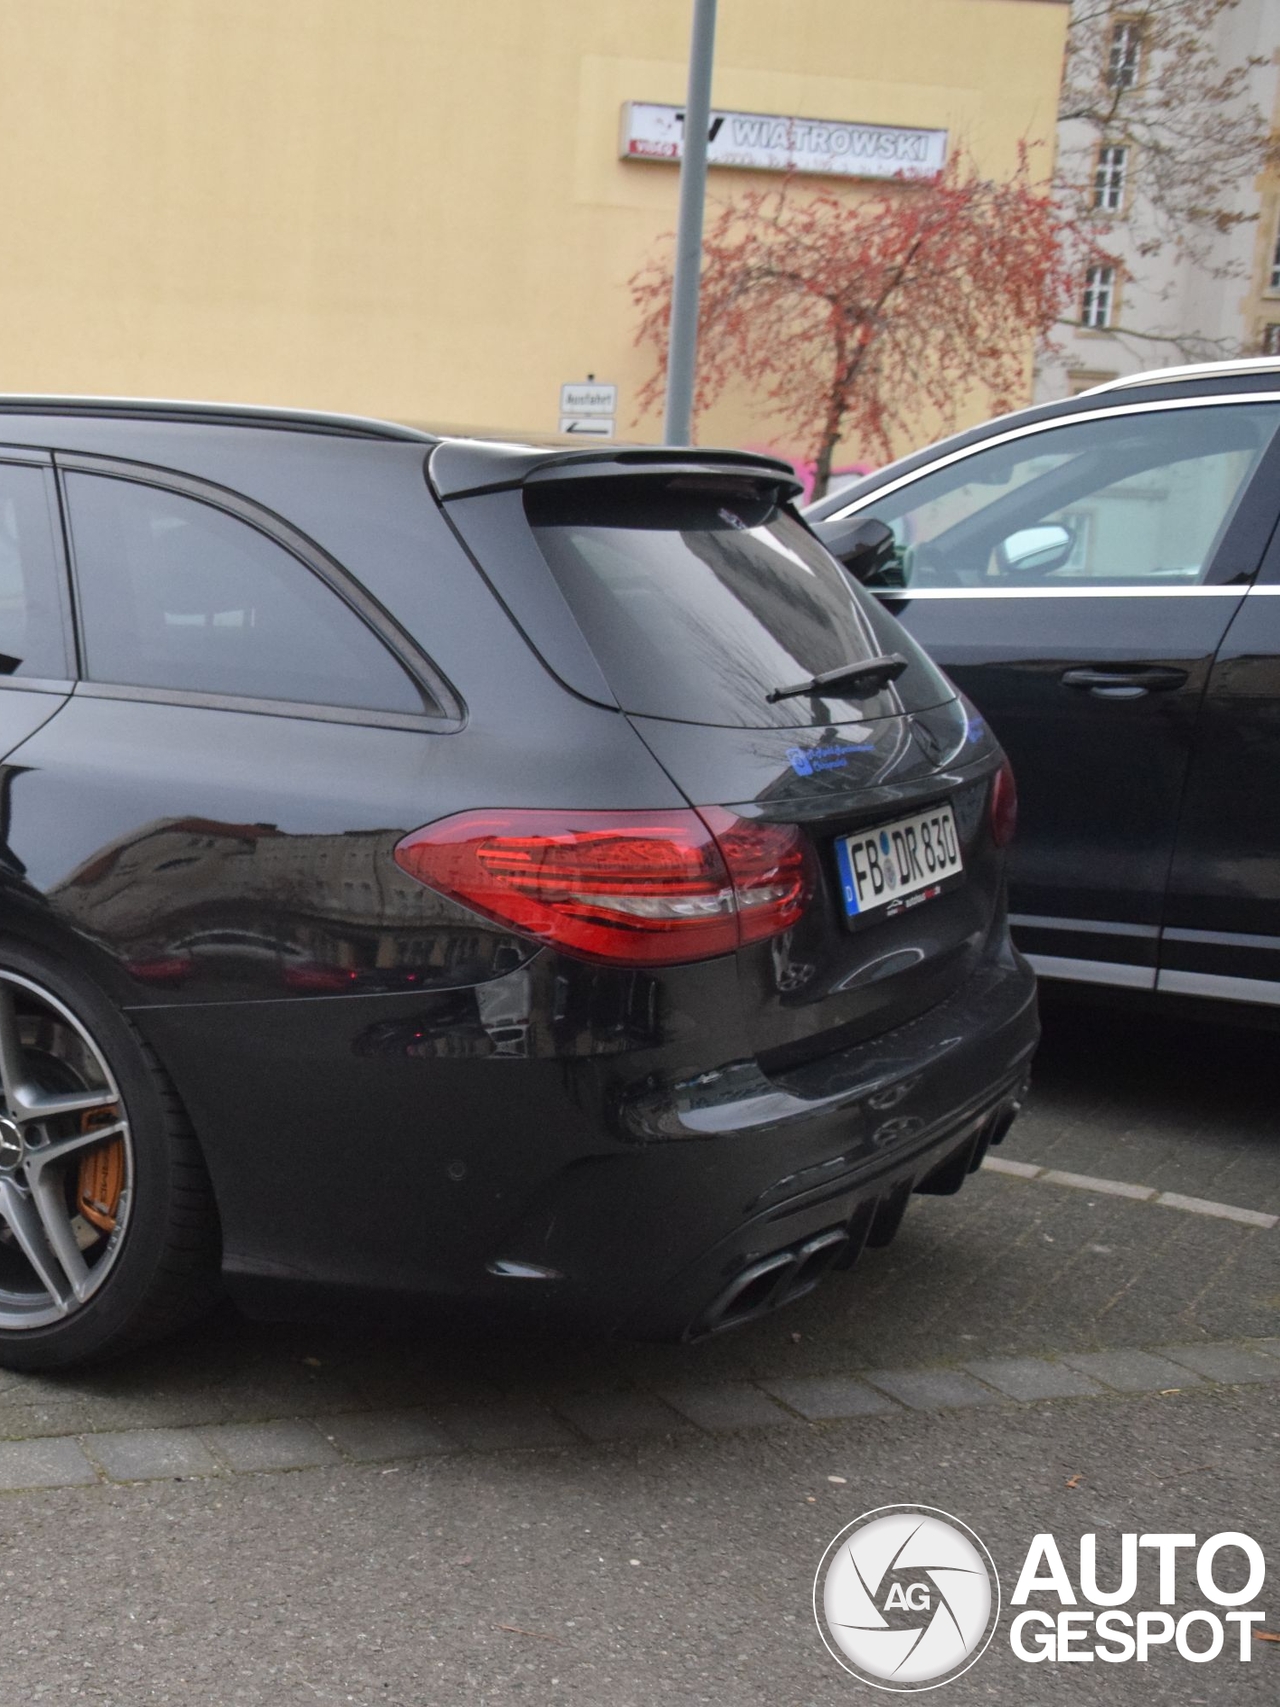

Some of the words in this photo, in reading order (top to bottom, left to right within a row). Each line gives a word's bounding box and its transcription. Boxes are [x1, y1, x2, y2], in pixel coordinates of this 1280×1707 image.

[731, 117, 930, 162] WIATROWSKI
[566, 393, 612, 405] Ausfahrt
[851, 838, 884, 902] FB
[891, 825, 924, 886] DR
[920, 815, 958, 874] 830
